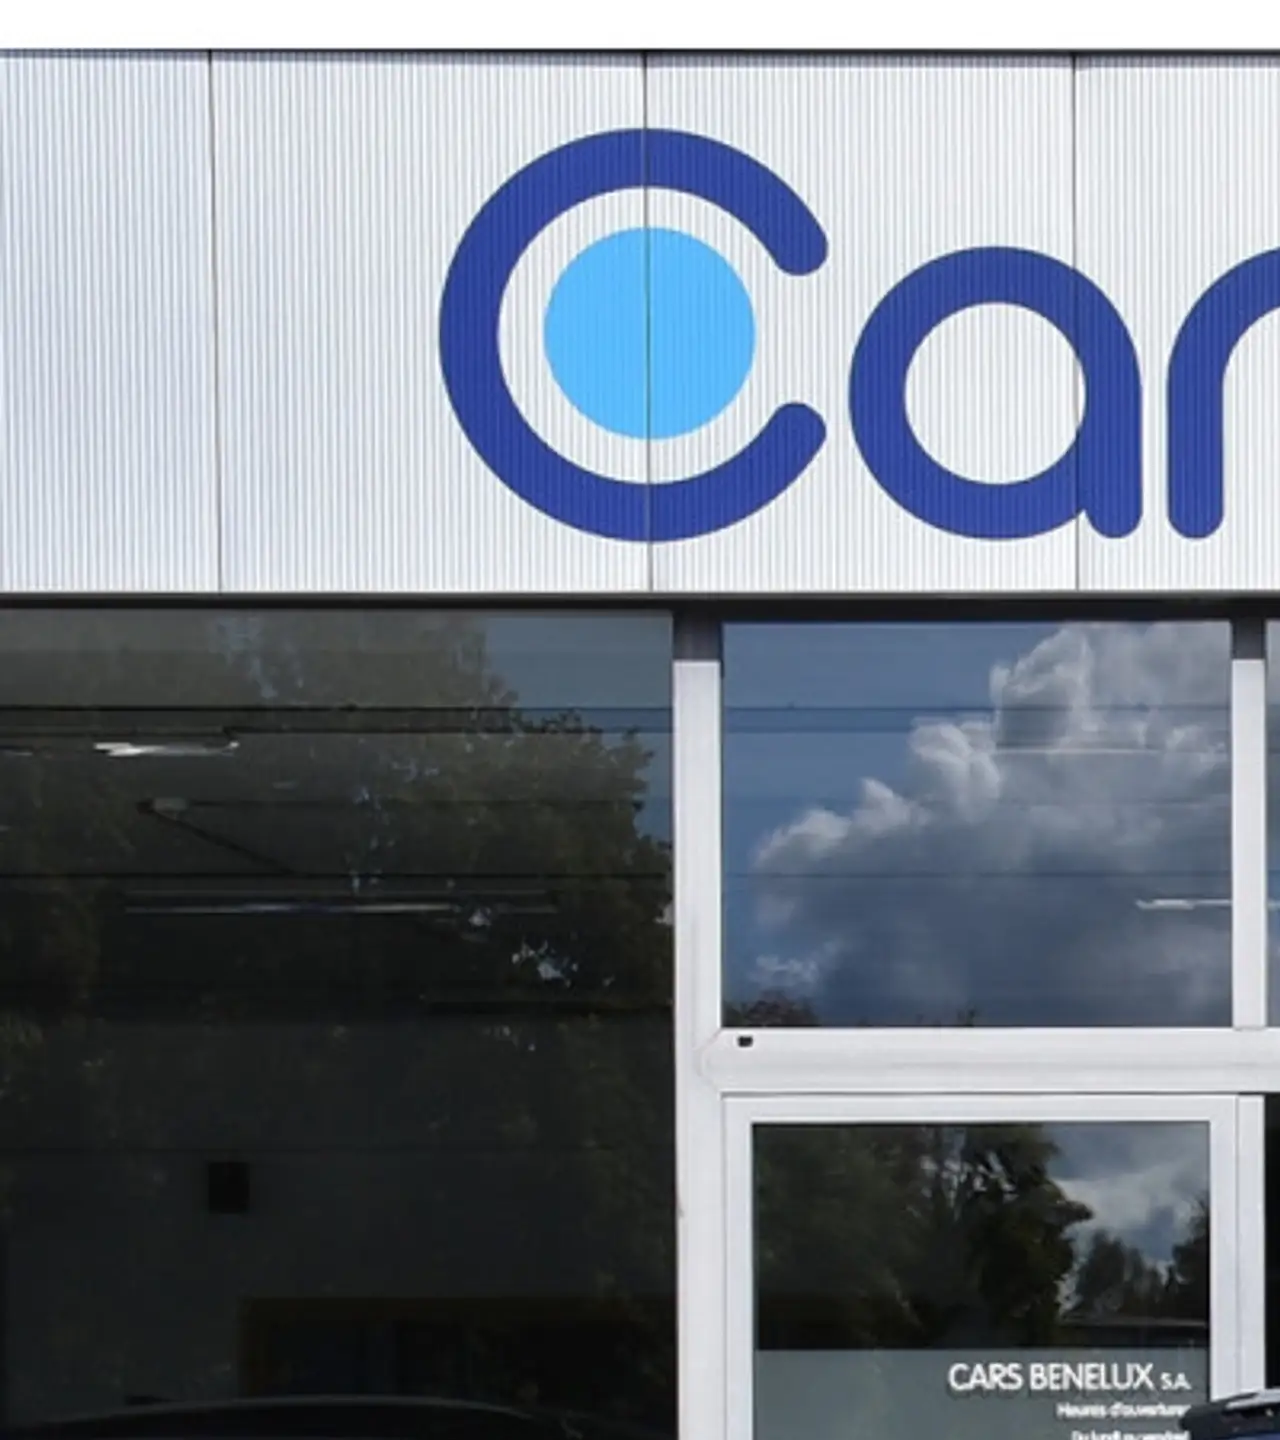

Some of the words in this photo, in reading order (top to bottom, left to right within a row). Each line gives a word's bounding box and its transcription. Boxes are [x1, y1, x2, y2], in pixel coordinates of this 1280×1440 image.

[948, 1363, 1023, 1391] CARS
[1029, 1363, 1155, 1391] BENELUX
[1057, 1402, 1106, 1418] Heures
